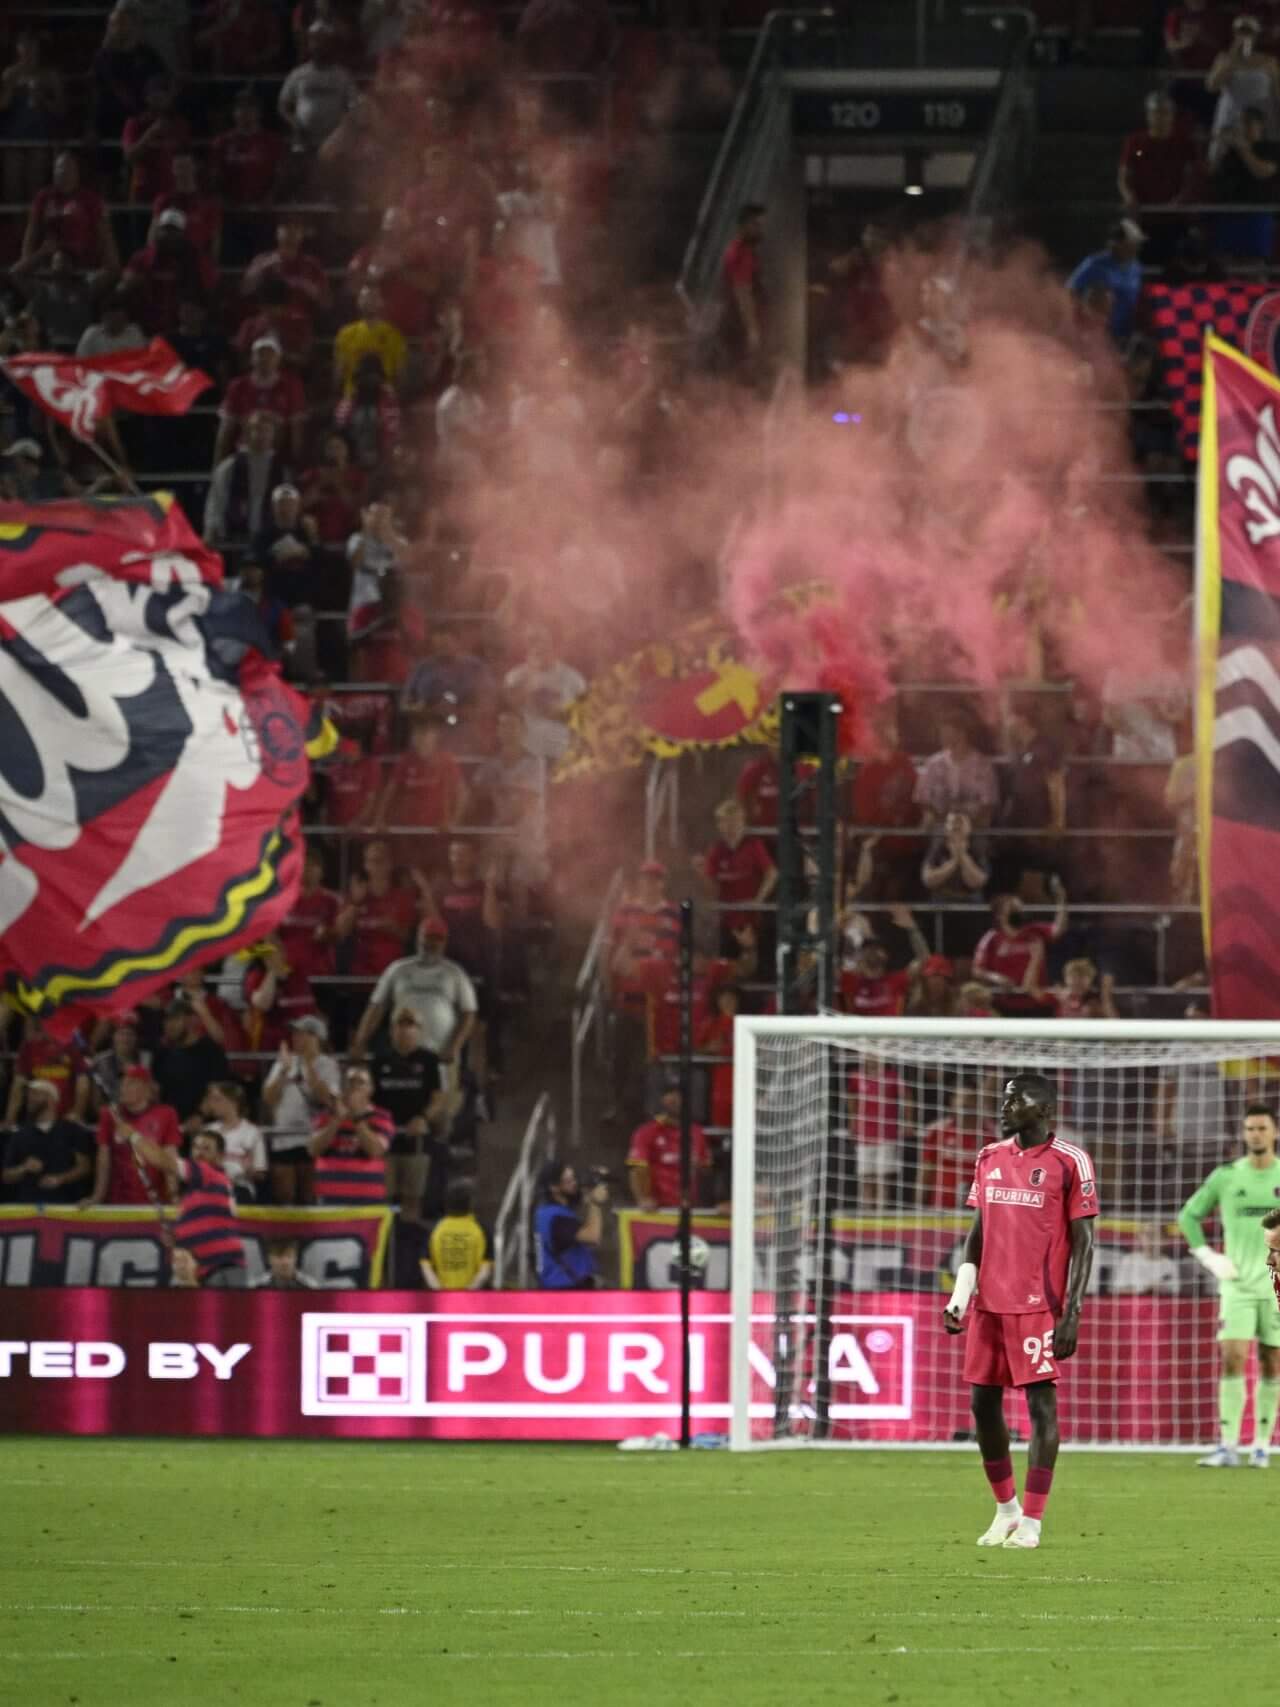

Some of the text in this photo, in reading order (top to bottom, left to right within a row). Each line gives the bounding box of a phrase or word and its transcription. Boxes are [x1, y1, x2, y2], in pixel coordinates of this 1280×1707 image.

[830, 101, 967, 128] 120 119
[995, 1190, 1041, 1205] PURINA
[147, 1342, 252, 1380] BY
[1023, 1329, 1055, 1365] 95
